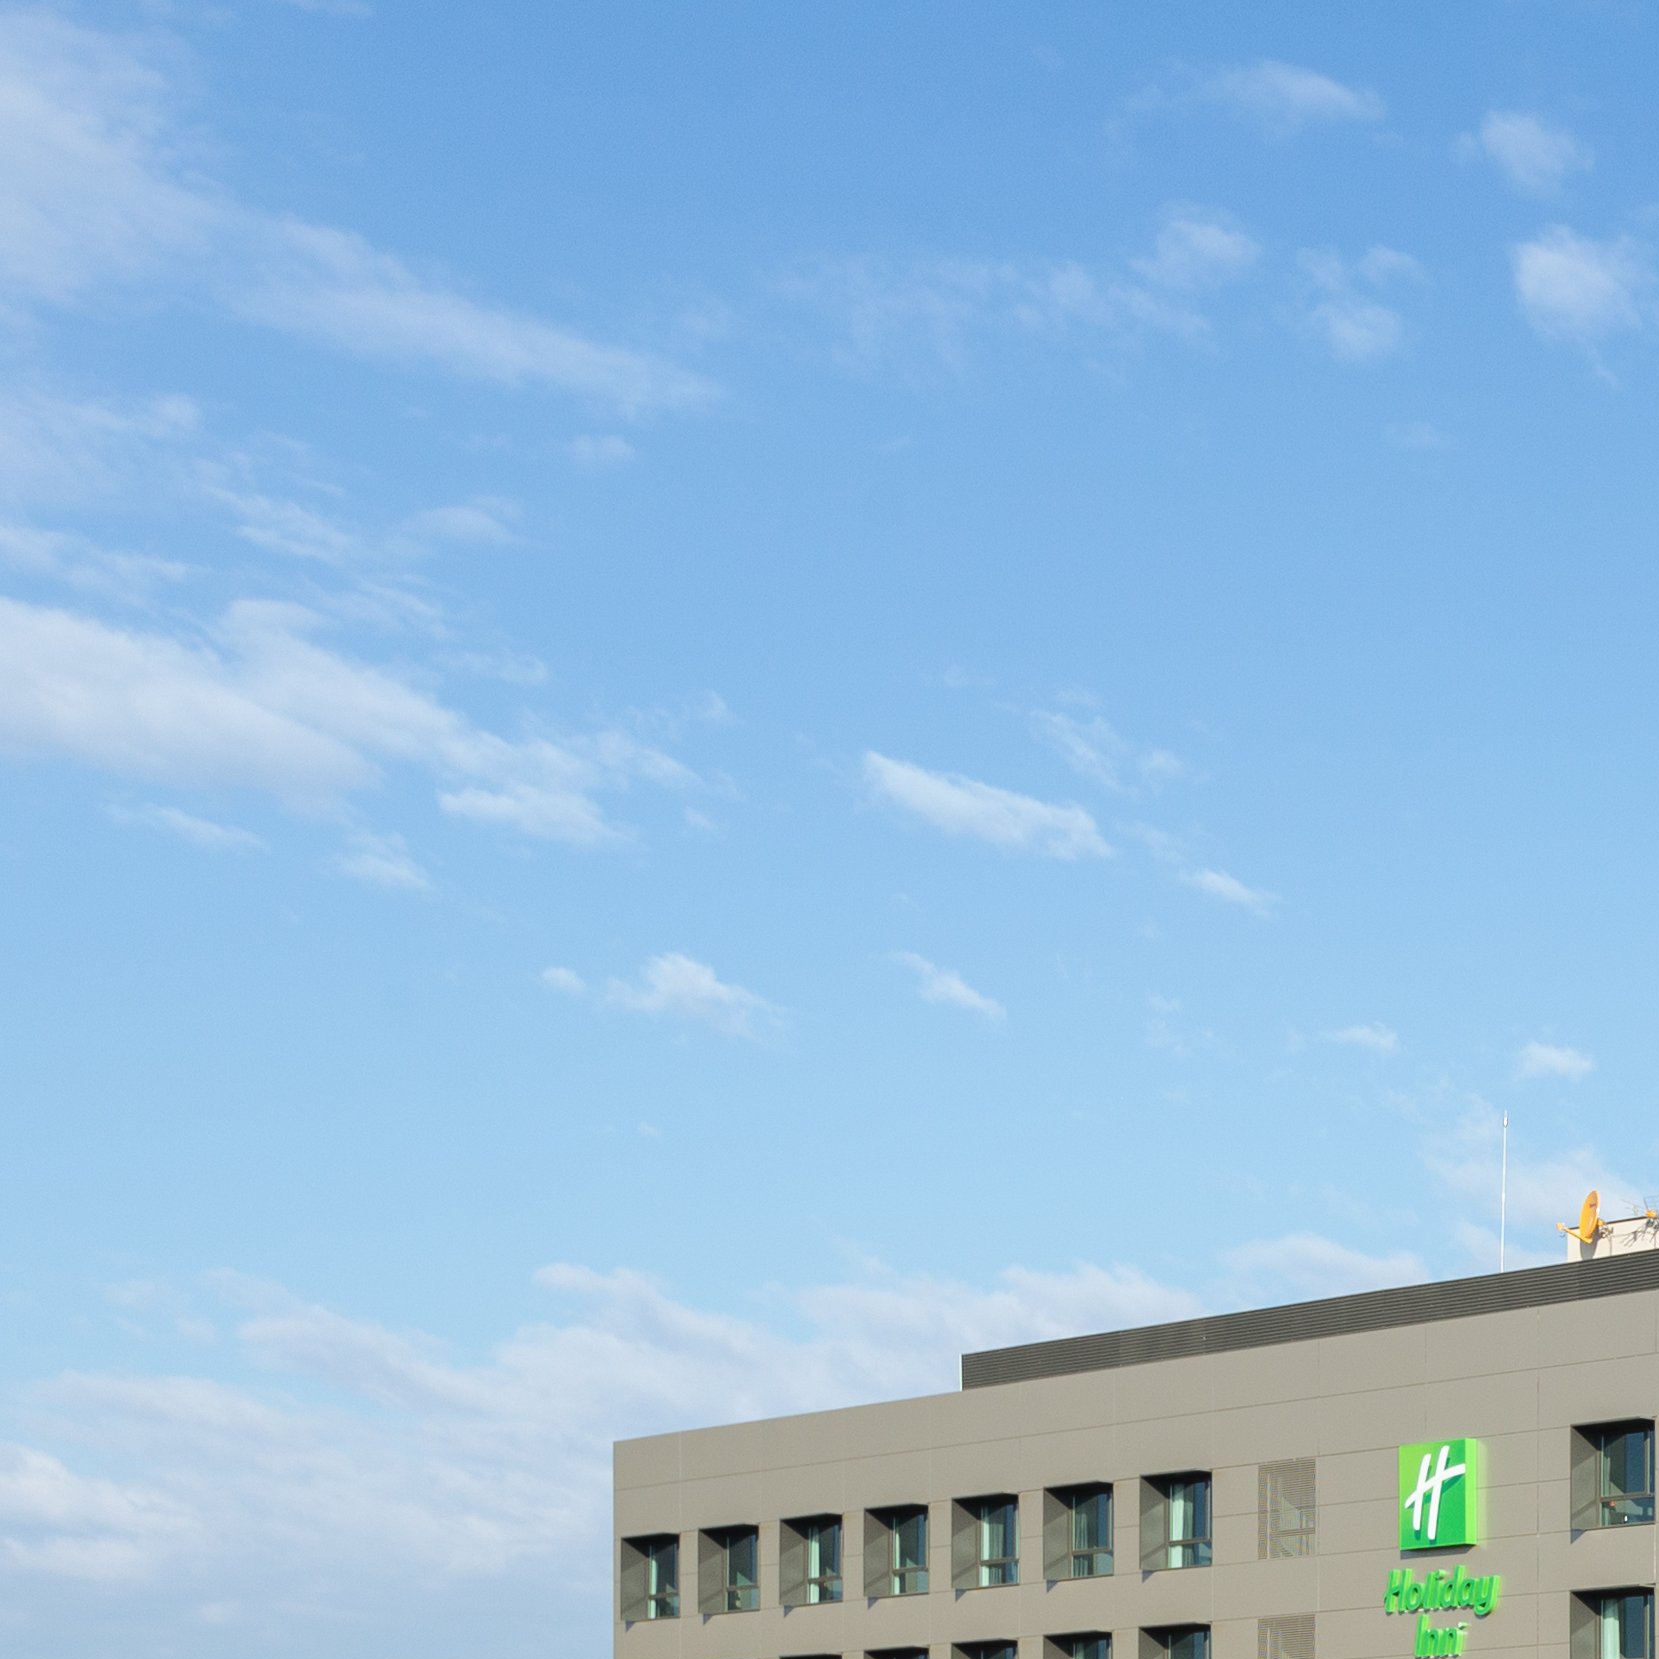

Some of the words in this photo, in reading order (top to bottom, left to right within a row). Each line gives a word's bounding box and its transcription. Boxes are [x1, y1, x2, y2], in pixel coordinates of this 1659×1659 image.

[1404, 1445, 1466, 1541] H
[1384, 1564, 1501, 1617] Holiday
[1414, 1612, 1468, 1659] Inn
